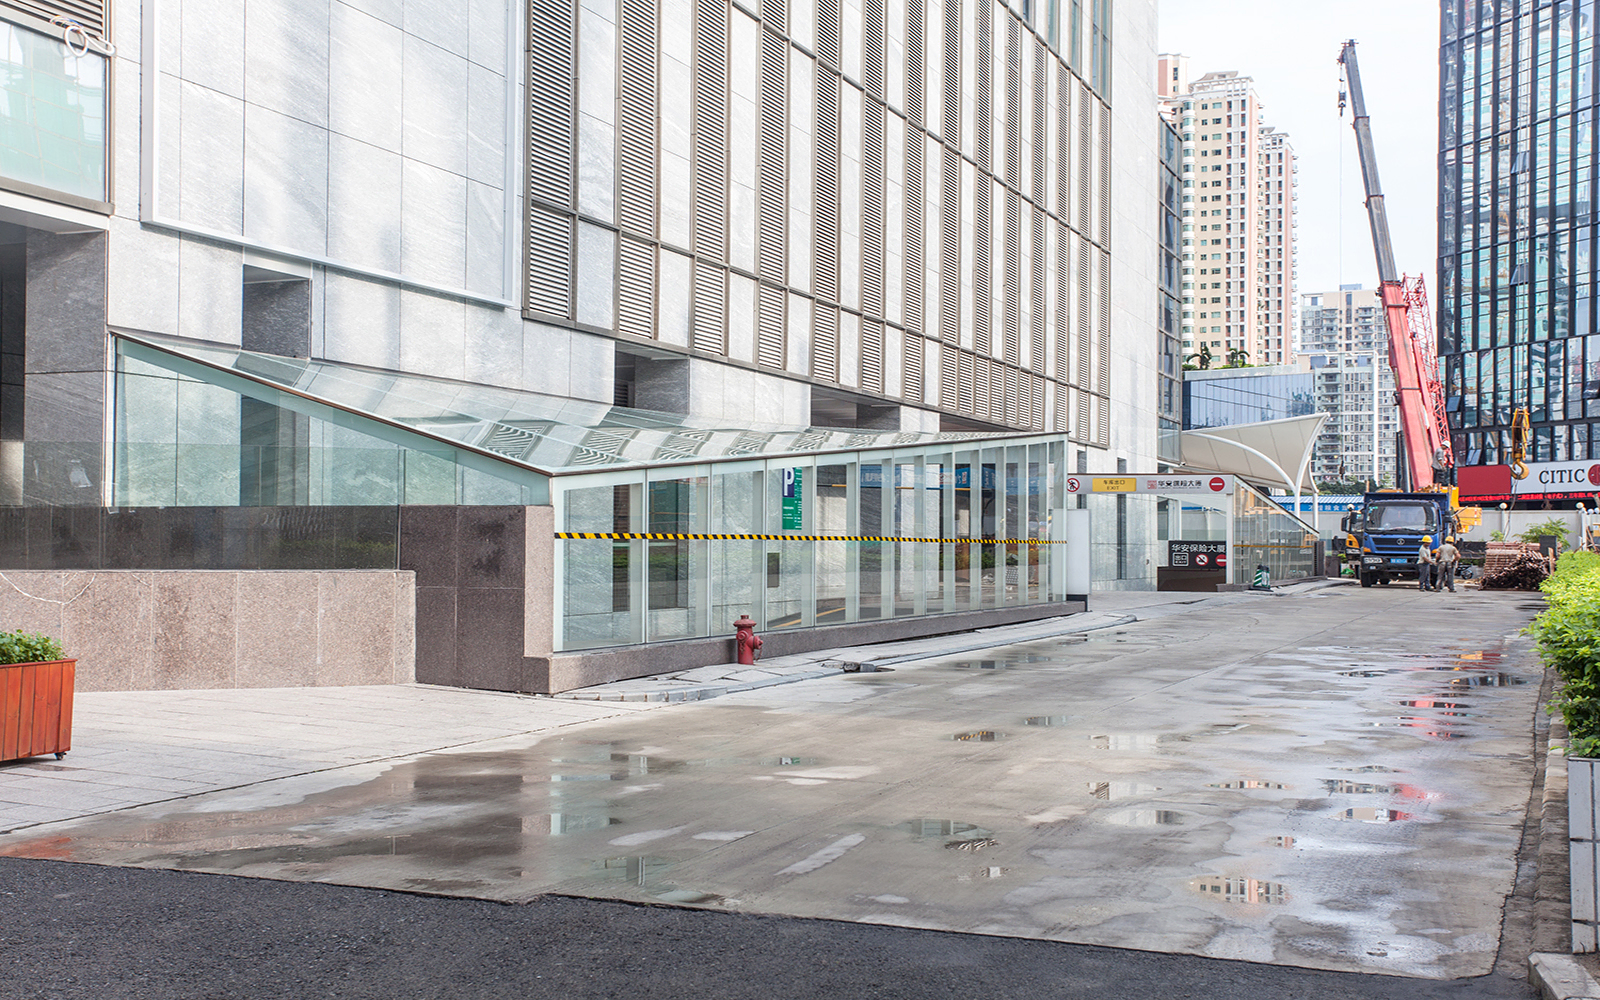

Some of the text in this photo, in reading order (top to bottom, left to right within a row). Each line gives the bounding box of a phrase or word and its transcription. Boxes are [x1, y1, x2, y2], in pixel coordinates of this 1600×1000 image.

[783, 467, 795, 496] P
[1539, 468, 1585, 484] CITIC
[1171, 544, 1226, 553] 华安保险大厦
